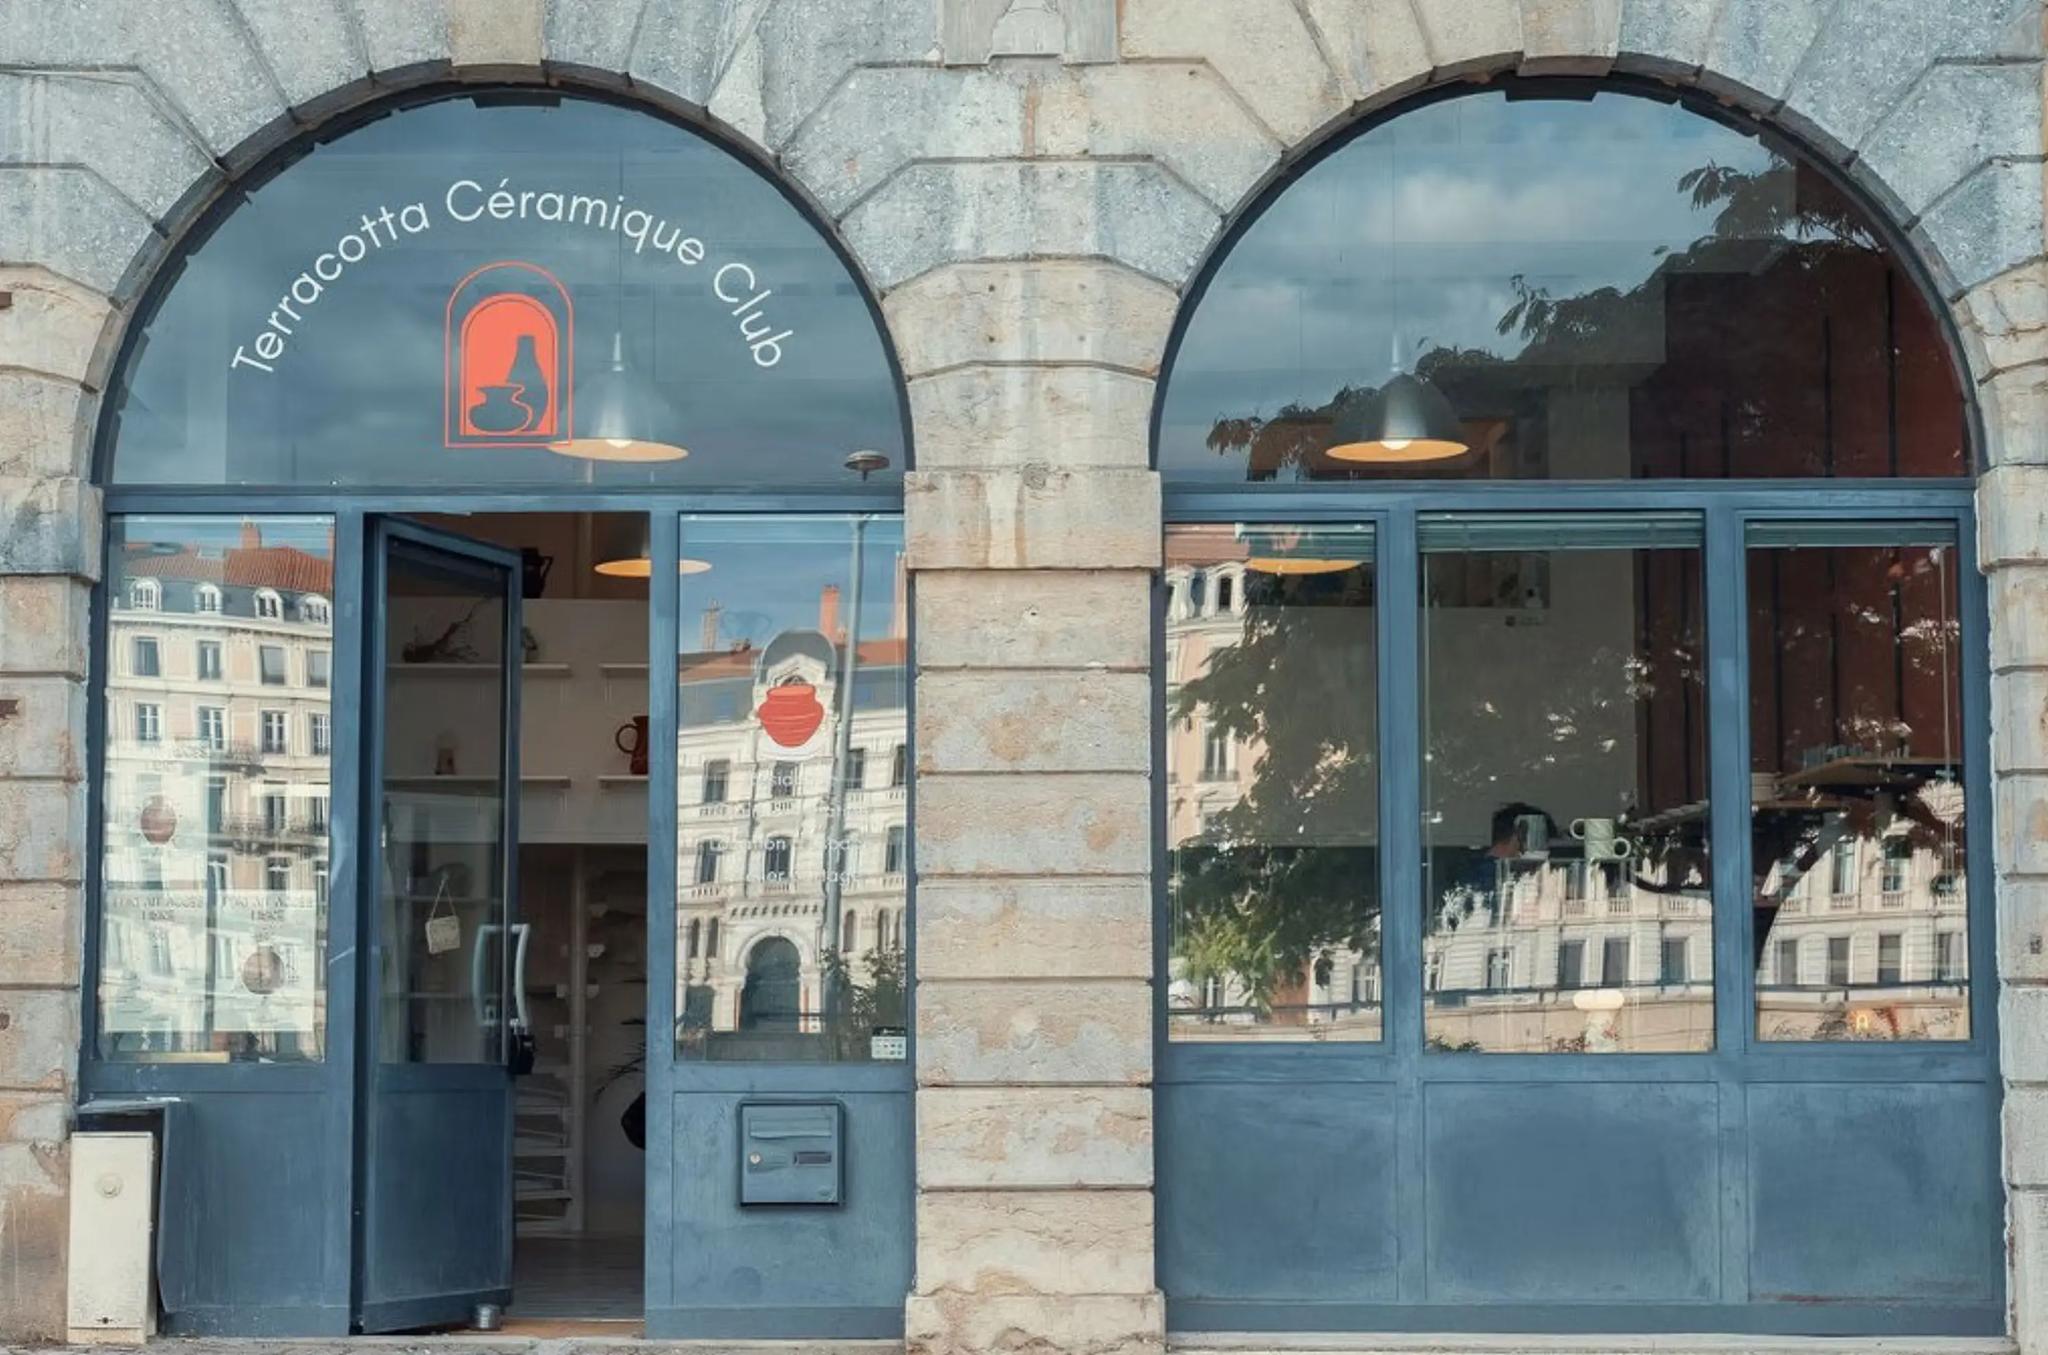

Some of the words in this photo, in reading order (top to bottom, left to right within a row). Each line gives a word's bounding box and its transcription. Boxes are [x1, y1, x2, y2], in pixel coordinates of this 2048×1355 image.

[231, 202, 430, 372] Terracotta
[446, 178, 705, 266] Céramique
[713, 263, 794, 367] Club
